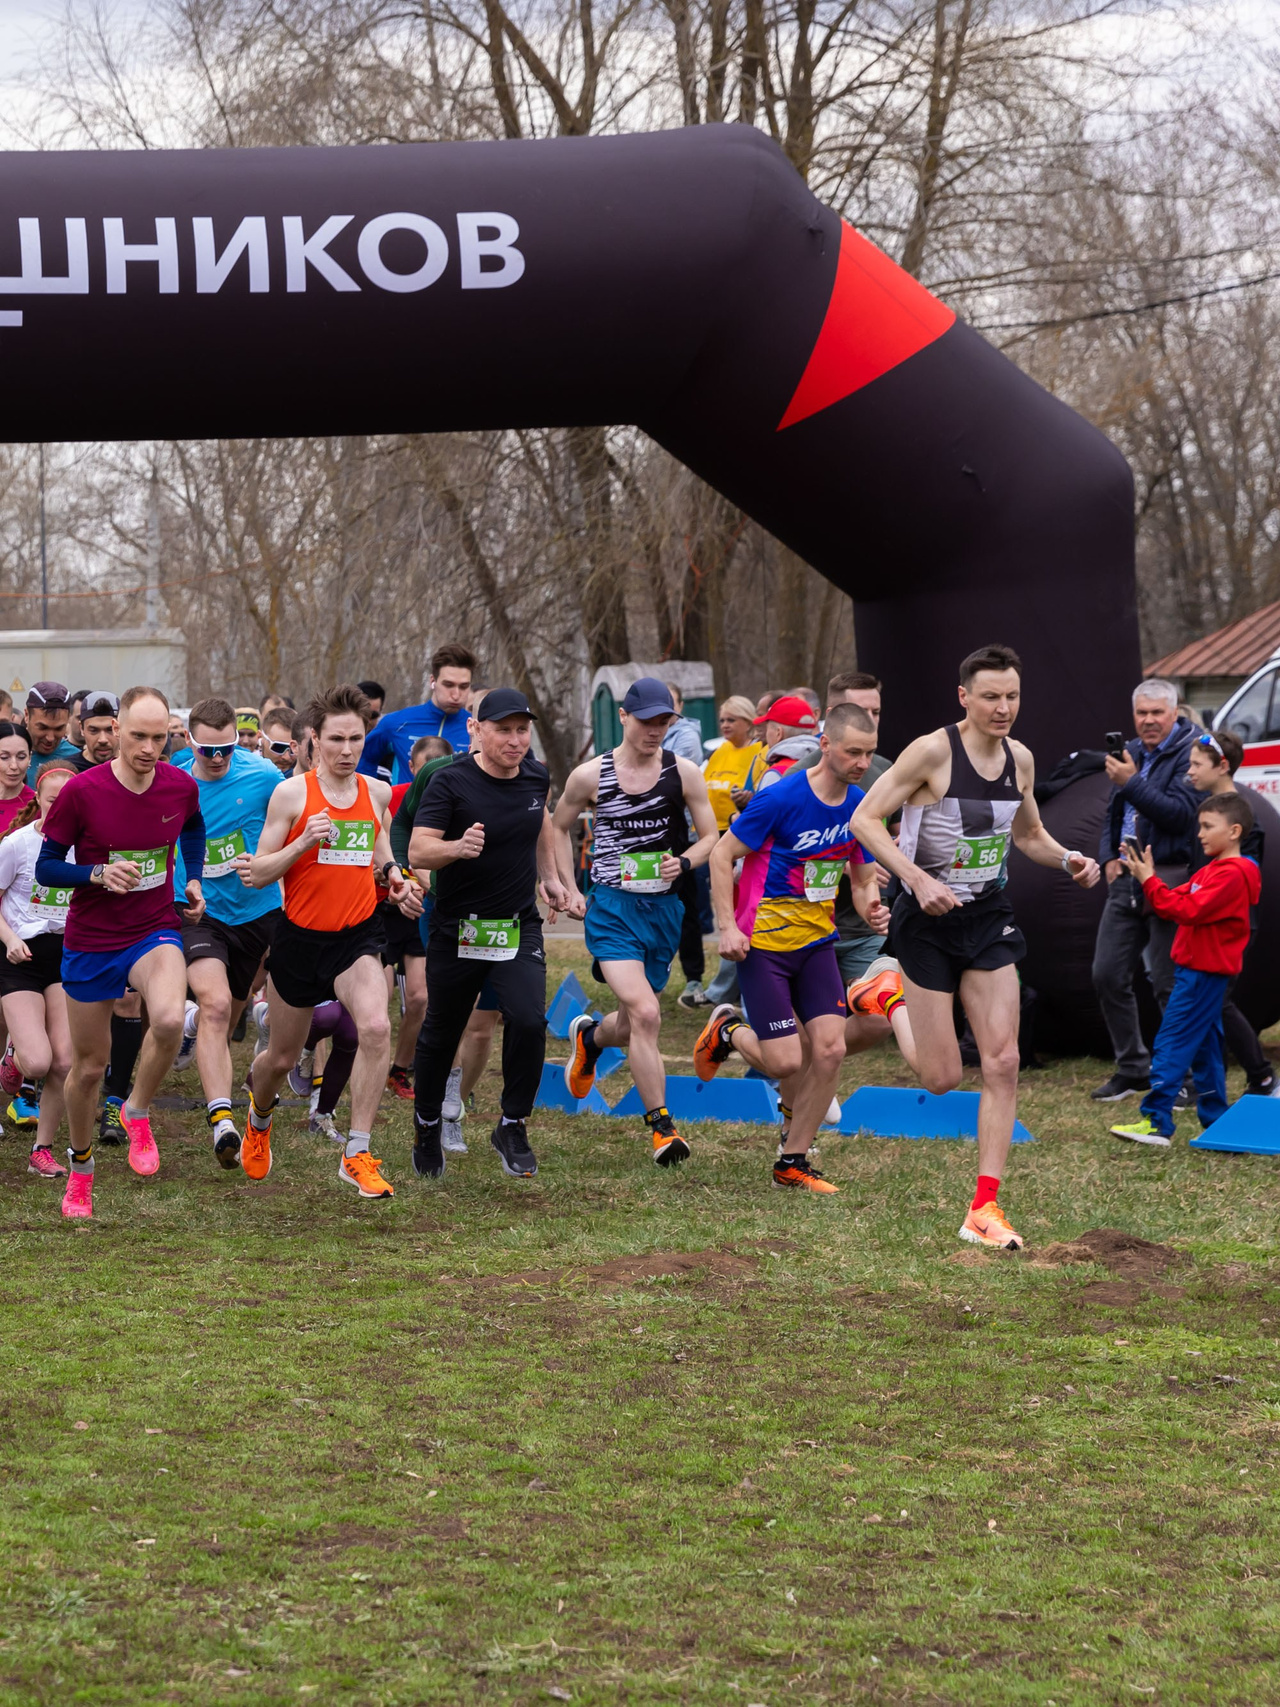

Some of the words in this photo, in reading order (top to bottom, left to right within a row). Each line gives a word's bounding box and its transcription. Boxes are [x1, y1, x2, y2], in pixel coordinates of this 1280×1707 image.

[612, 816, 671, 829] RUNDAY
[346, 831, 369, 848] 24
[218, 843, 236, 860] 18
[978, 848, 998, 865] 56
[140, 859, 156, 876] 19
[821, 871, 838, 885] 40
[486, 931, 508, 946] 78
[769, 1018, 797, 1031] INEO
